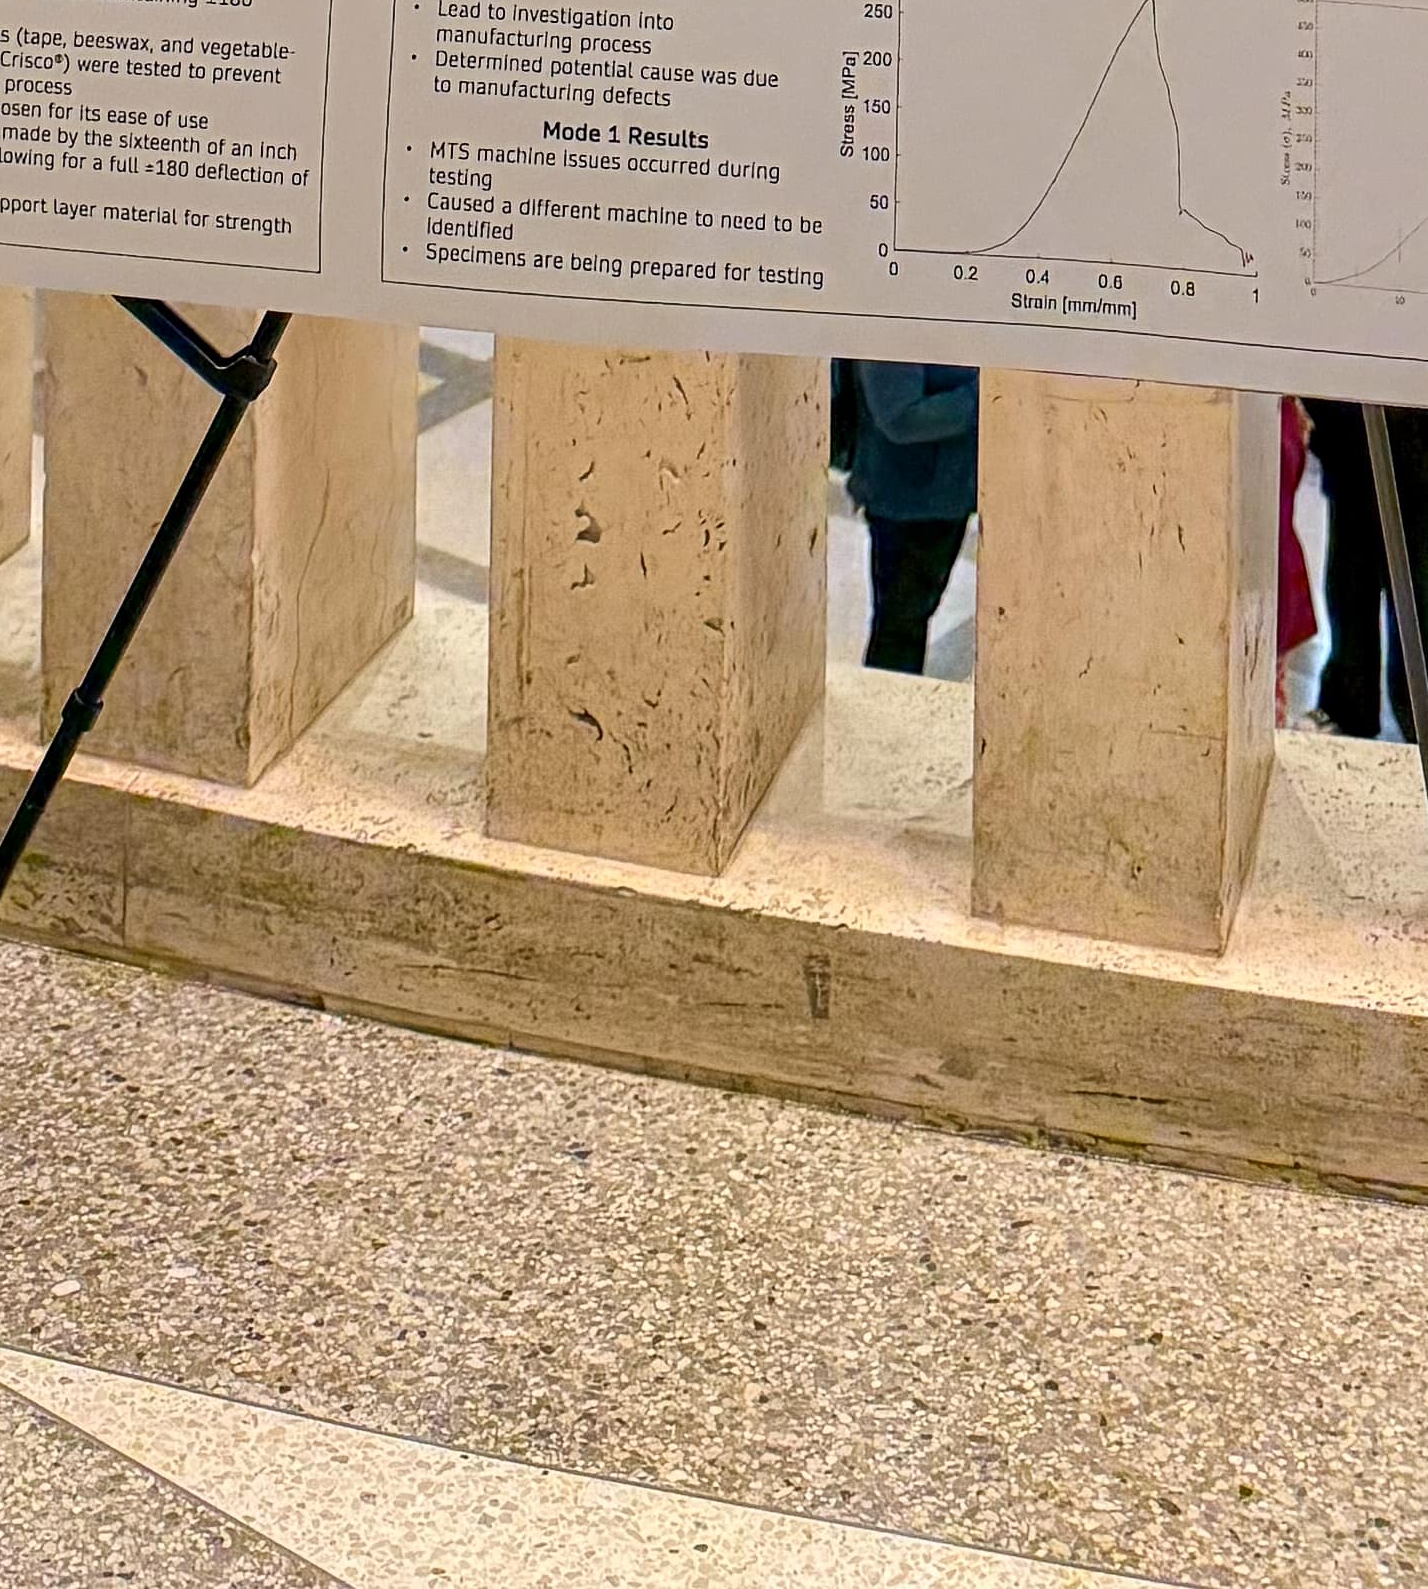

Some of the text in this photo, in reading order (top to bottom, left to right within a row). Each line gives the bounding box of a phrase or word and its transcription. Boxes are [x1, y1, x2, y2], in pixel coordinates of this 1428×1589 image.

[487, 3, 506, 21] to
[512, 3, 631, 30] investigation
[638, 11, 674, 31] into
[840, 52, 859, 157] Stress [MPa]
[543, 120, 709, 149] Mode 1 Results
[1011, 292, 1137, 321] Strain [mm/mm]
